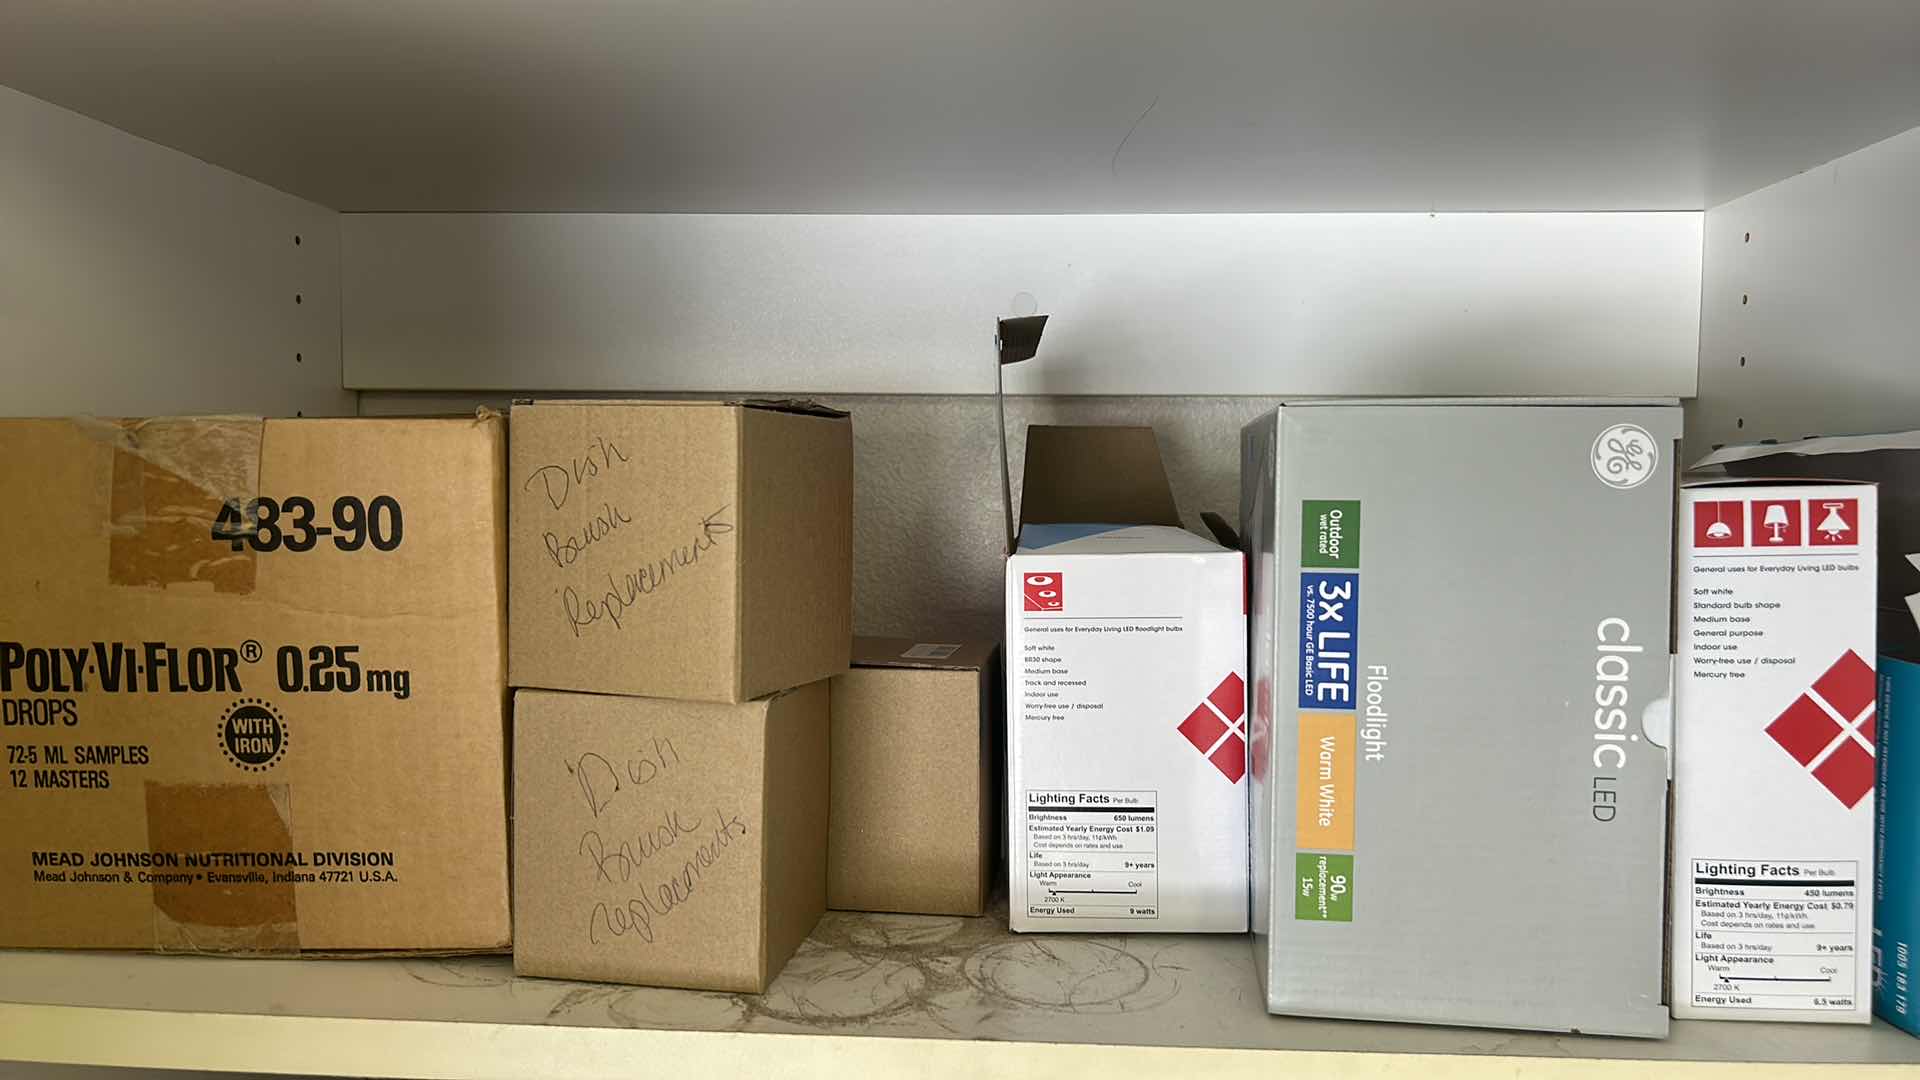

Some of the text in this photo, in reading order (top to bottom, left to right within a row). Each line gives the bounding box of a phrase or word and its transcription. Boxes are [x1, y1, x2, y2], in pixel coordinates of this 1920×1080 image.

[524, 437, 629, 510] Dish
[211, 495, 403, 552] 483-90
[542, 503, 631, 568] Brush
[1319, 513, 1328, 554] wet rated
[1329, 509, 1343, 559] Outdoor
[1759, 565, 1795, 573] Everyday
[1797, 564, 1820, 573] Living
[1306, 599, 1315, 619] 7500
[1755, 602, 1781, 610] shape
[1075, 626, 1102, 634] Everyday
[1103, 626, 1121, 634] Living
[1135, 625, 1165, 633] floodlight
[1306, 621, 1315, 640] hour
[1729, 630, 1763, 638] purpose
[1305, 641, 1314, 654] GE
[1317, 580, 1351, 702] 3x LIFE
[1305, 655, 1315, 678] Basic
[1693, 657, 1735, 665] Worry-free
[1760, 657, 1795, 666] disposal
[277, 645, 361, 692] 0.25
[366, 669, 410, 700] mg
[1693, 671, 1727, 679] Mercury
[1305, 680, 1313, 695] LED
[1593, 617, 1643, 768] classic
[2, 698, 78, 725] DROPS
[1076, 703, 1103, 711] disposal
[1360, 665, 1389, 760] Floodlight
[1025, 714, 1050, 722] Mercury
[231, 718, 273, 734] WITH
[234, 737, 273, 754] IRON
[7, 745, 149, 765] 72-5 ML SAMPLES
[9, 770, 109, 788] 12 MASTERS
[565, 737, 679, 818] Dish
[1318, 736, 1335, 826] Warm White
[1029, 793, 1110, 805] Lighting Facts
[1593, 776, 1617, 822] LED
[1066, 825, 1087, 833] Yearly
[579, 811, 701, 882] Brush
[32, 852, 393, 867] MEAD JOHNSON NUTRITIONAL DIVISION
[34, 870, 398, 885] Mead Johnson & Company Evansville, Indiana 47721 U.S.A.
[1696, 863, 1800, 877] Lighting Facts
[1695, 886, 1744, 896] Brightness
[1695, 899, 1740, 908] Estimated
[1743, 901, 1771, 910] Yearly
[1773, 901, 1804, 911] Energy
[1695, 931, 1712, 939] Life
[1816, 943, 1827, 951] 9+
[1829, 944, 1853, 952] years
[1695, 953, 1774, 964] Light Appearance
[1713, 983, 1732, 991] 2700
[1695, 994, 1726, 1004] Energy
[1729, 996, 1752, 1004] Used
